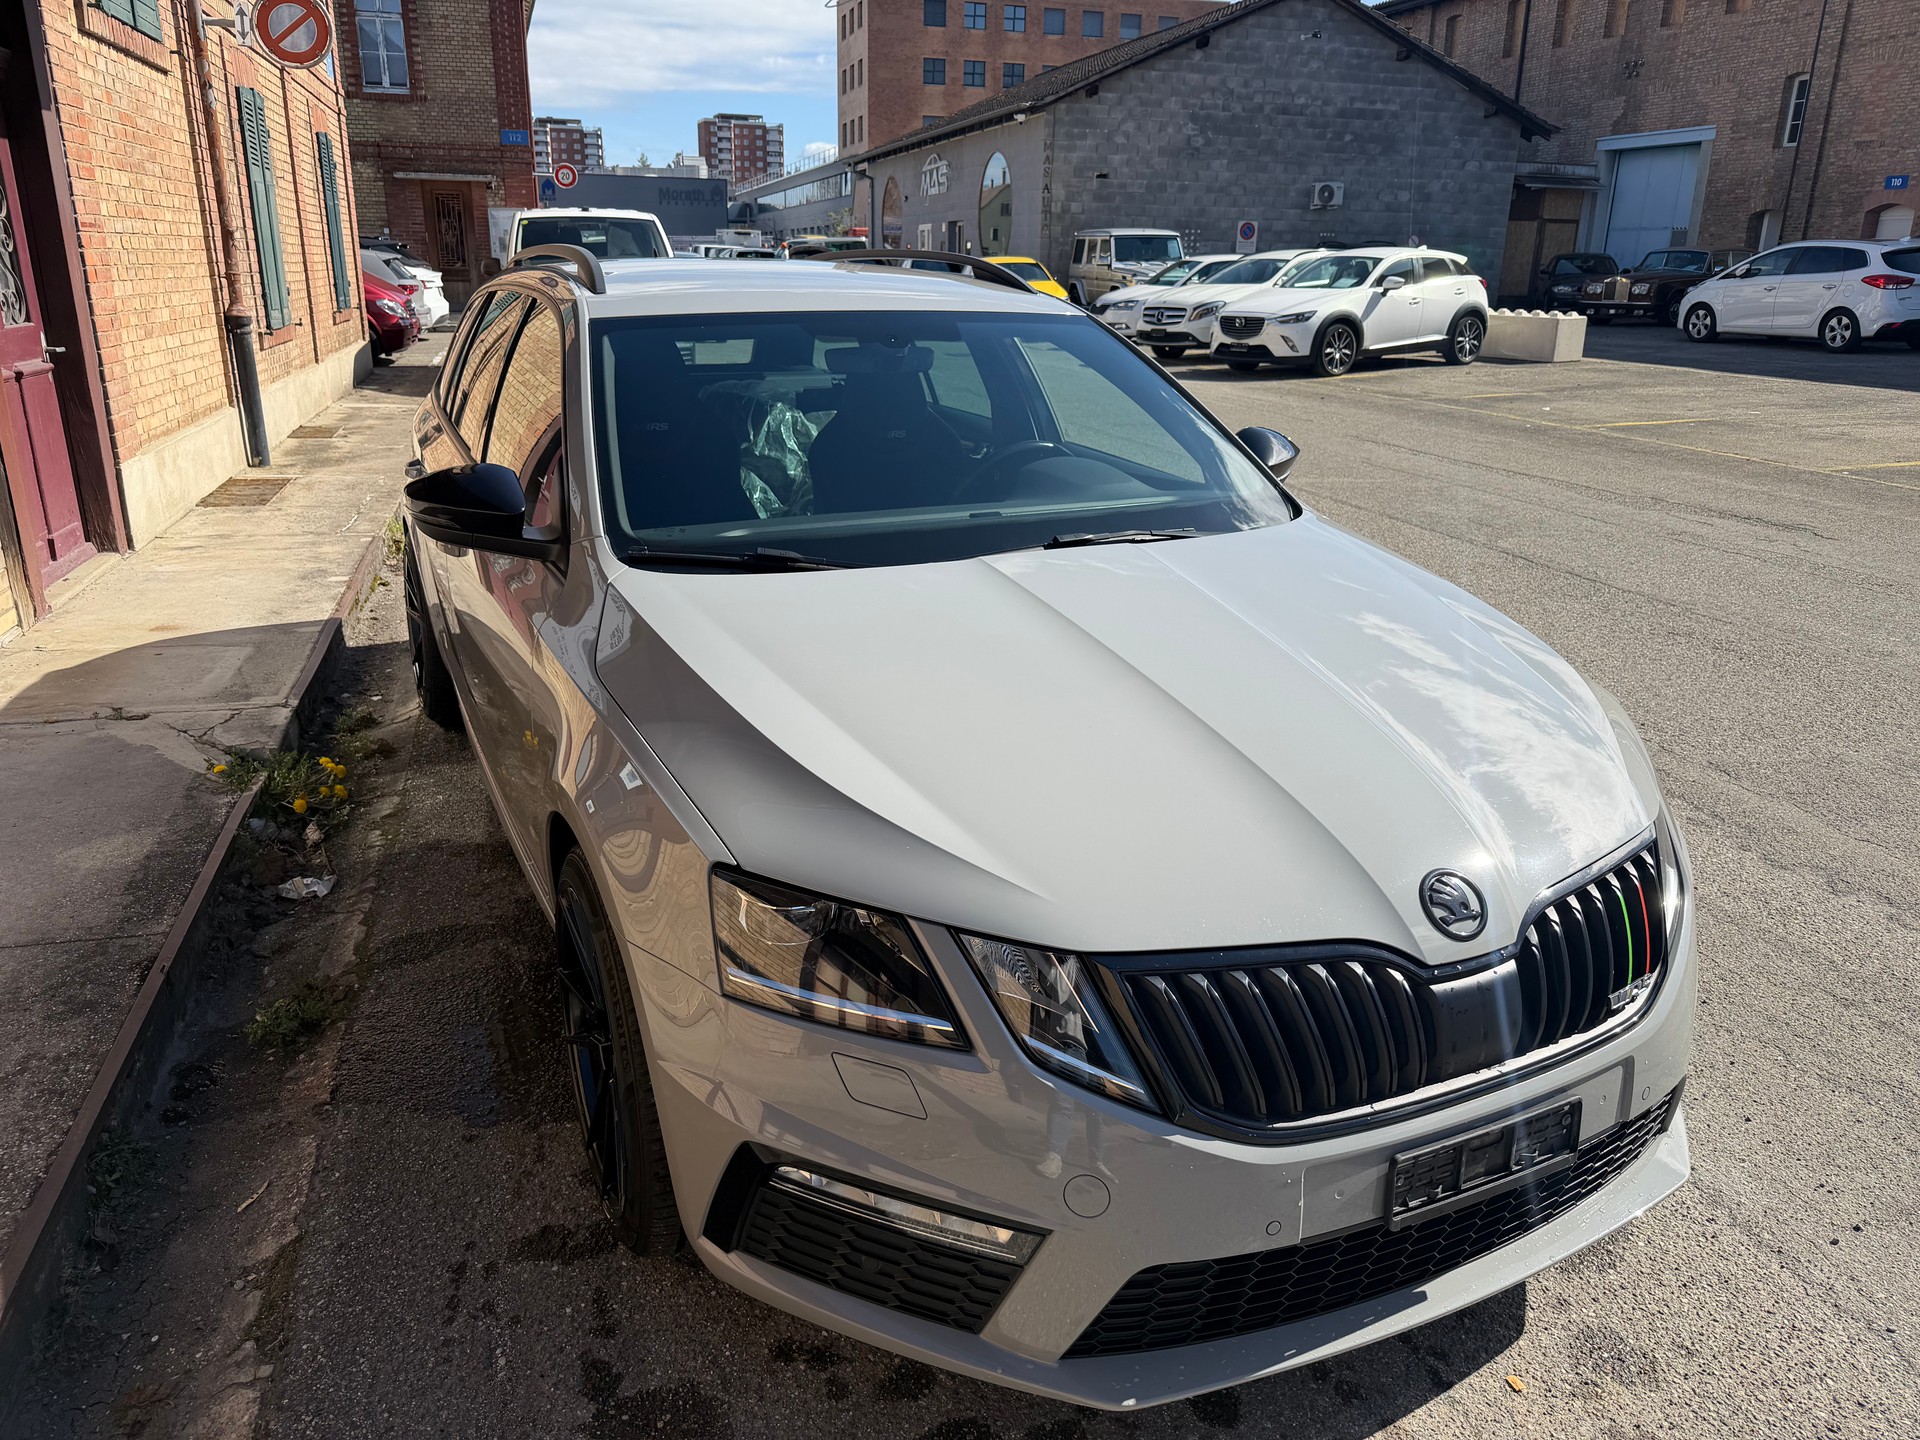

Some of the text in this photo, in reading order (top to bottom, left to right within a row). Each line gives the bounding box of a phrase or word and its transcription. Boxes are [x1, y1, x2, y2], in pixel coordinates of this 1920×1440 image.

[508, 134, 521, 142] 112
[1043, 141, 1053, 178] MAS
[561, 172, 570, 180] 20
[920, 160, 949, 198] MAS
[1891, 178, 1902, 186] 110
[658, 187, 704, 201] Morath
